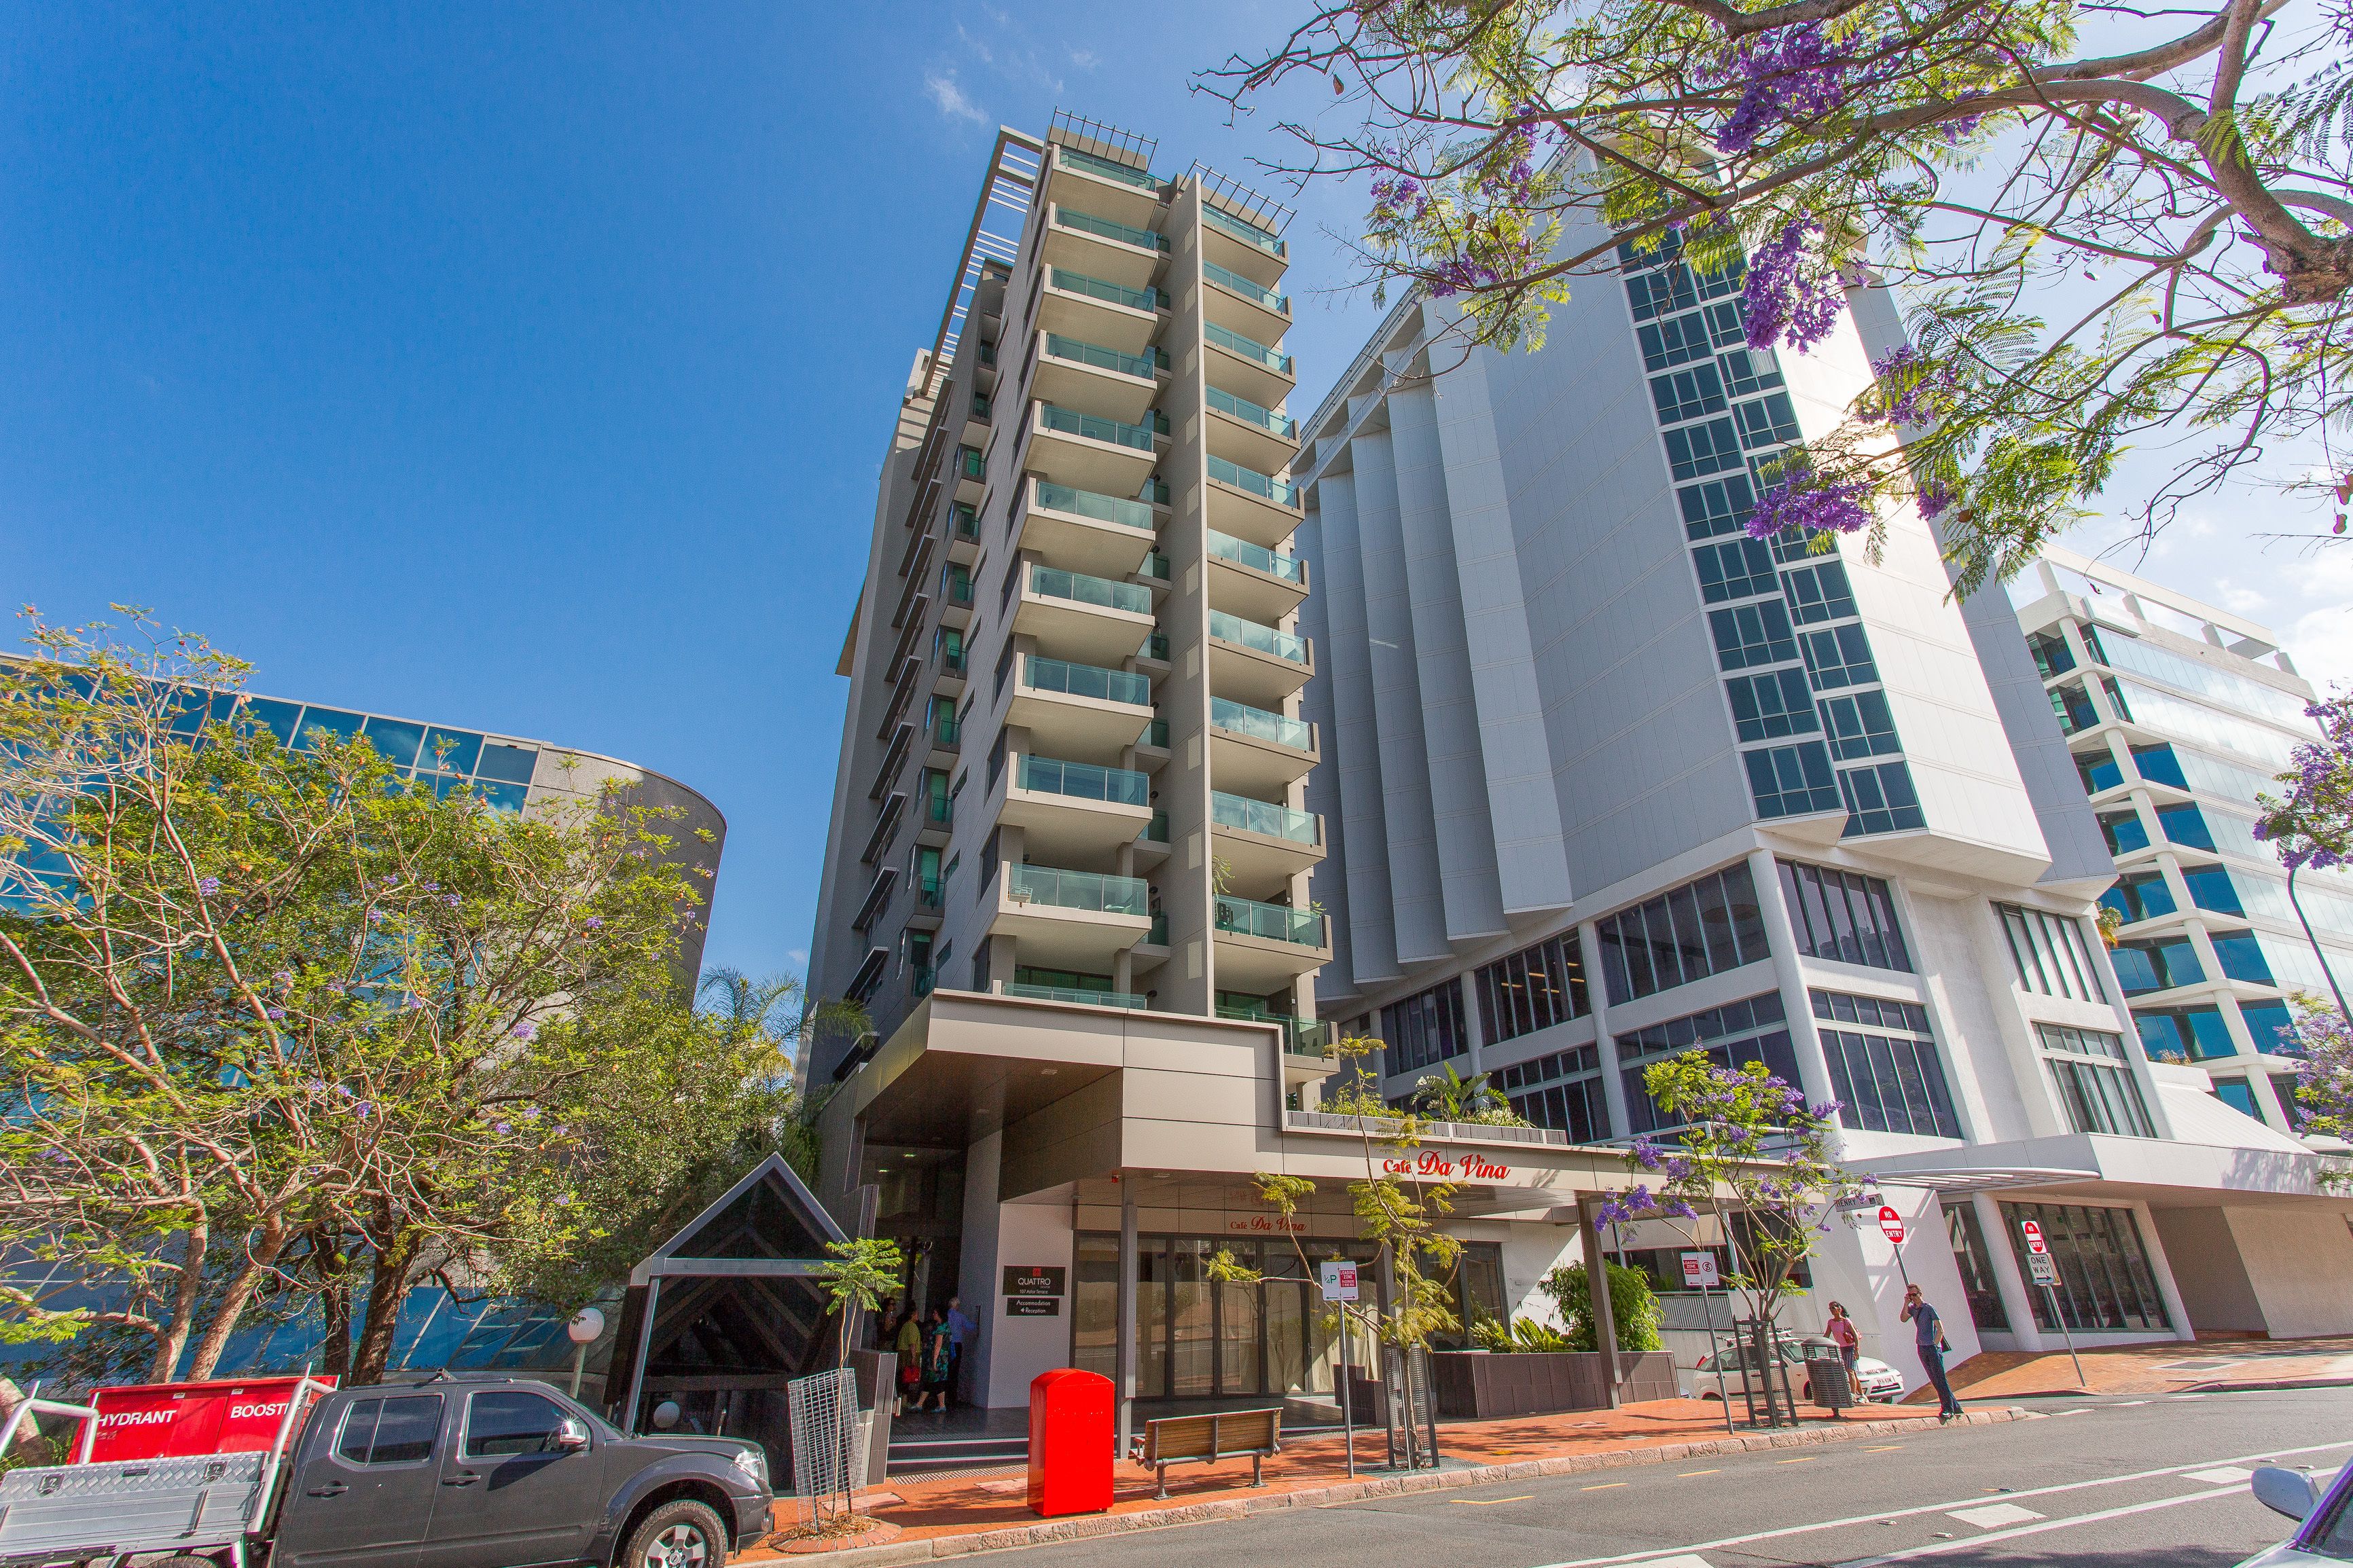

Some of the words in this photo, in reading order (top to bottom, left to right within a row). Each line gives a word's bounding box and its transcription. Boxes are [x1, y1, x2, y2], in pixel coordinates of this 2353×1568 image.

[1417, 1150, 1455, 1176] Da
[1460, 1154, 1511, 1180] Vina
[1230, 1221, 1248, 1229] Café
[1250, 1216, 1274, 1230] Da
[1276, 1217, 1307, 1231] Vina
[1885, 1230, 1903, 1238] ENTRY
[2030, 1256, 2047, 1264] ONE
[1018, 1277, 1051, 1286] QUATTRO
[98, 1410, 177, 1427] HYDRANT
